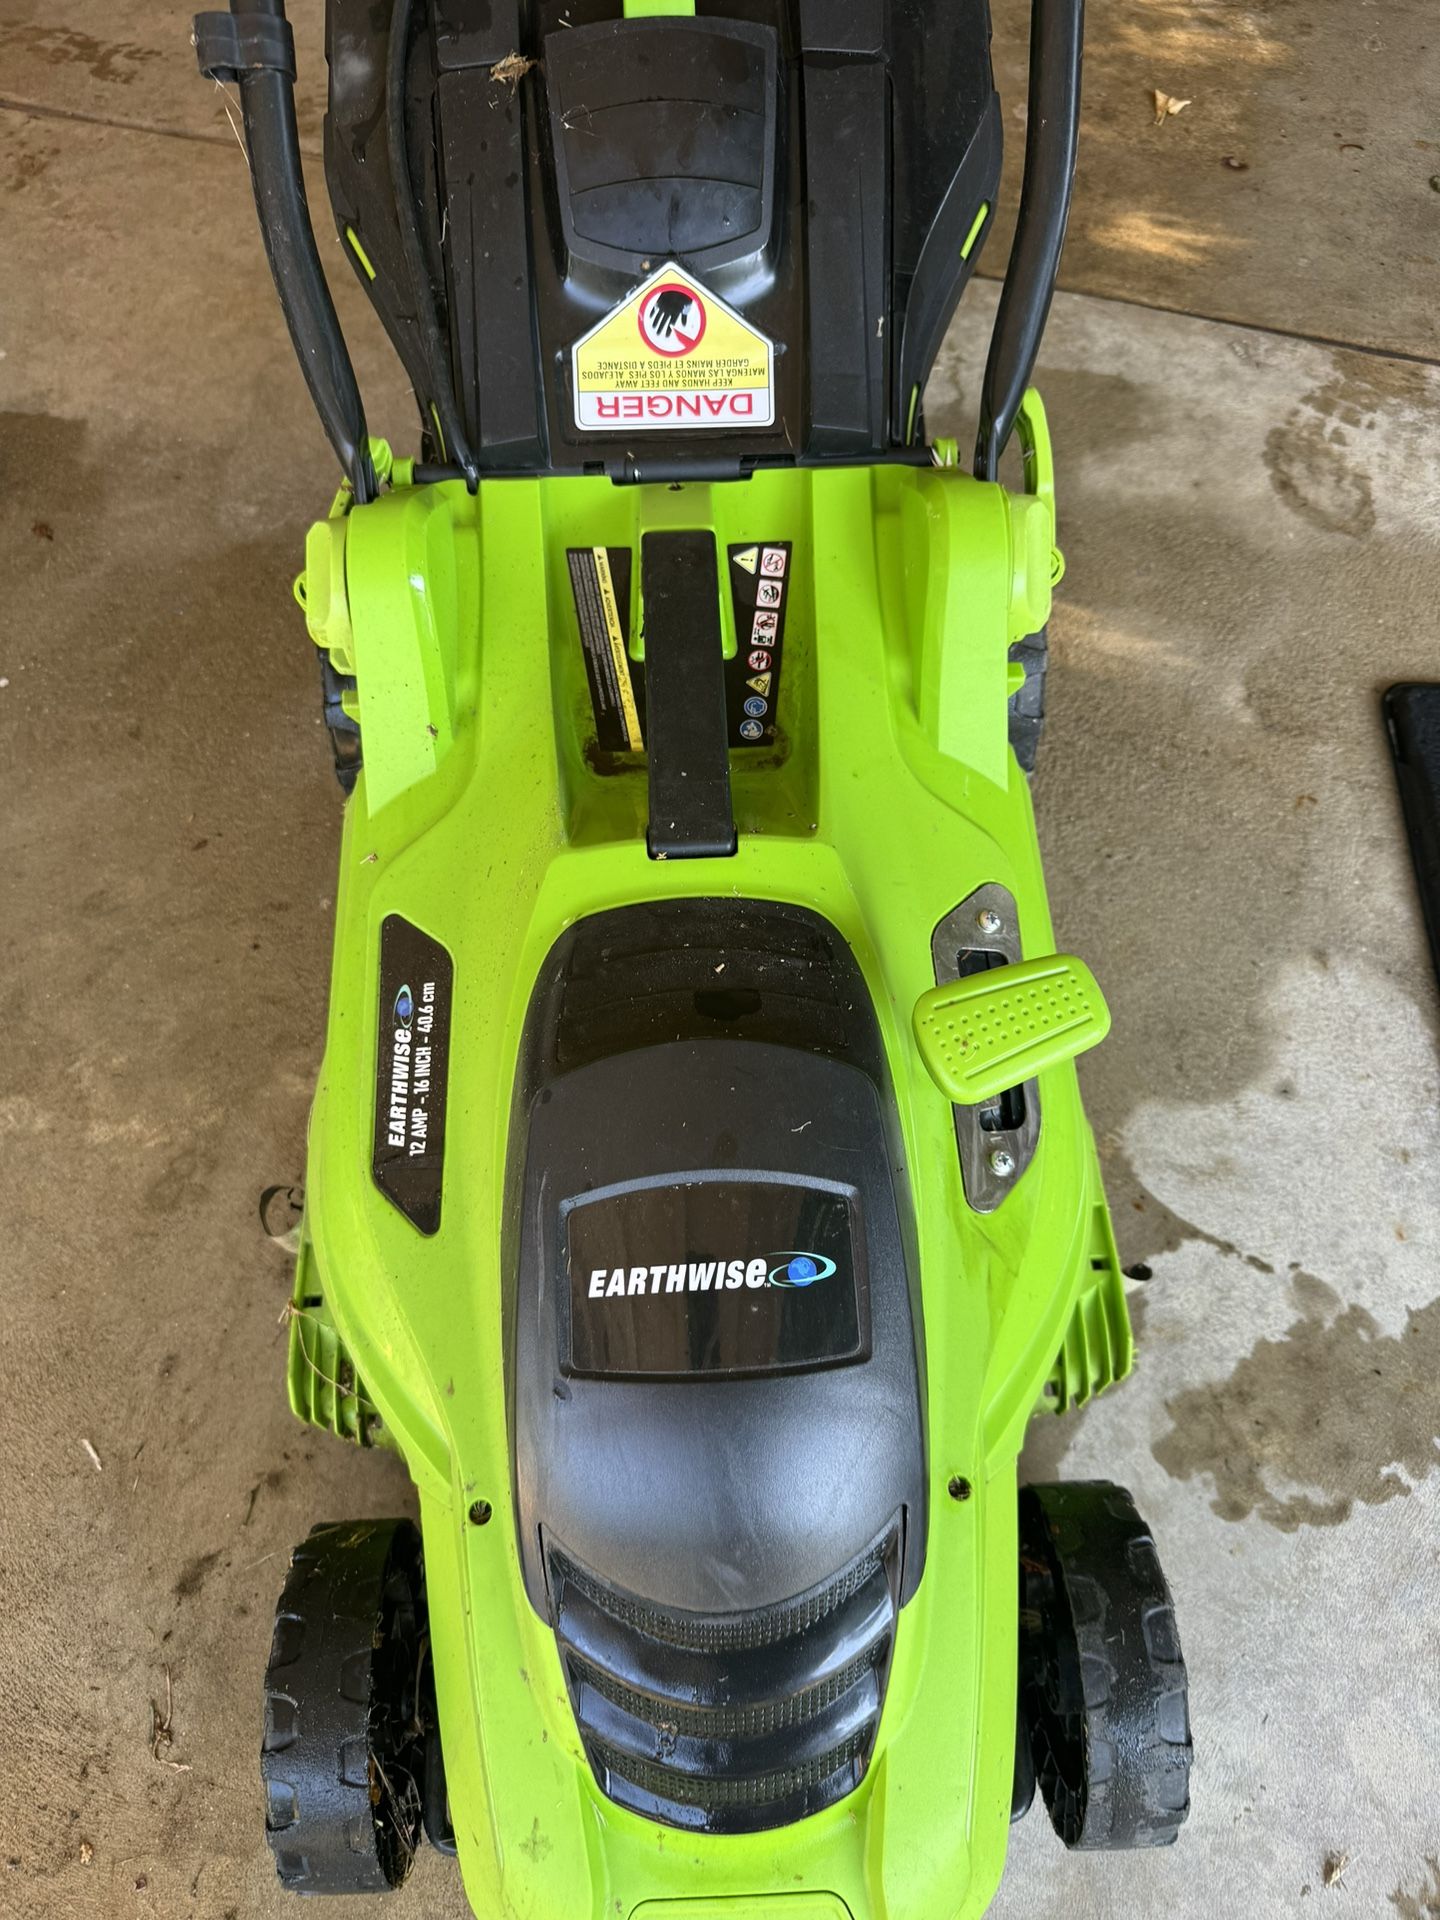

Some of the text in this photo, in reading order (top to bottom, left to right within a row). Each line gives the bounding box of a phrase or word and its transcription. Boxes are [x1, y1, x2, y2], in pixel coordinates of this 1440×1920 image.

[597, 361, 638, 371] DISTANCE
[647, 360, 672, 370] PIEDS
[675, 360, 684, 369] ET
[686, 359, 713, 369] MAINS
[715, 358, 750, 368] GARDER
[581, 368, 765, 380] MATENGA LAS MANOS Y LOS PIES ALEJADOS
[615, 380, 639, 389] AWAY
[662, 379, 681, 389] AND
[682, 378, 711, 388] HANDS
[712, 378, 733, 387] KEEP
[596, 393, 753, 419] DANGER
[422, 982, 436, 1002] cm
[417, 1005, 435, 1033] 40.6
[414, 1046, 432, 1078] INCH
[413, 1079, 431, 1094] 16
[411, 1107, 428, 1138] AMP
[409, 1141, 427, 1157] 12
